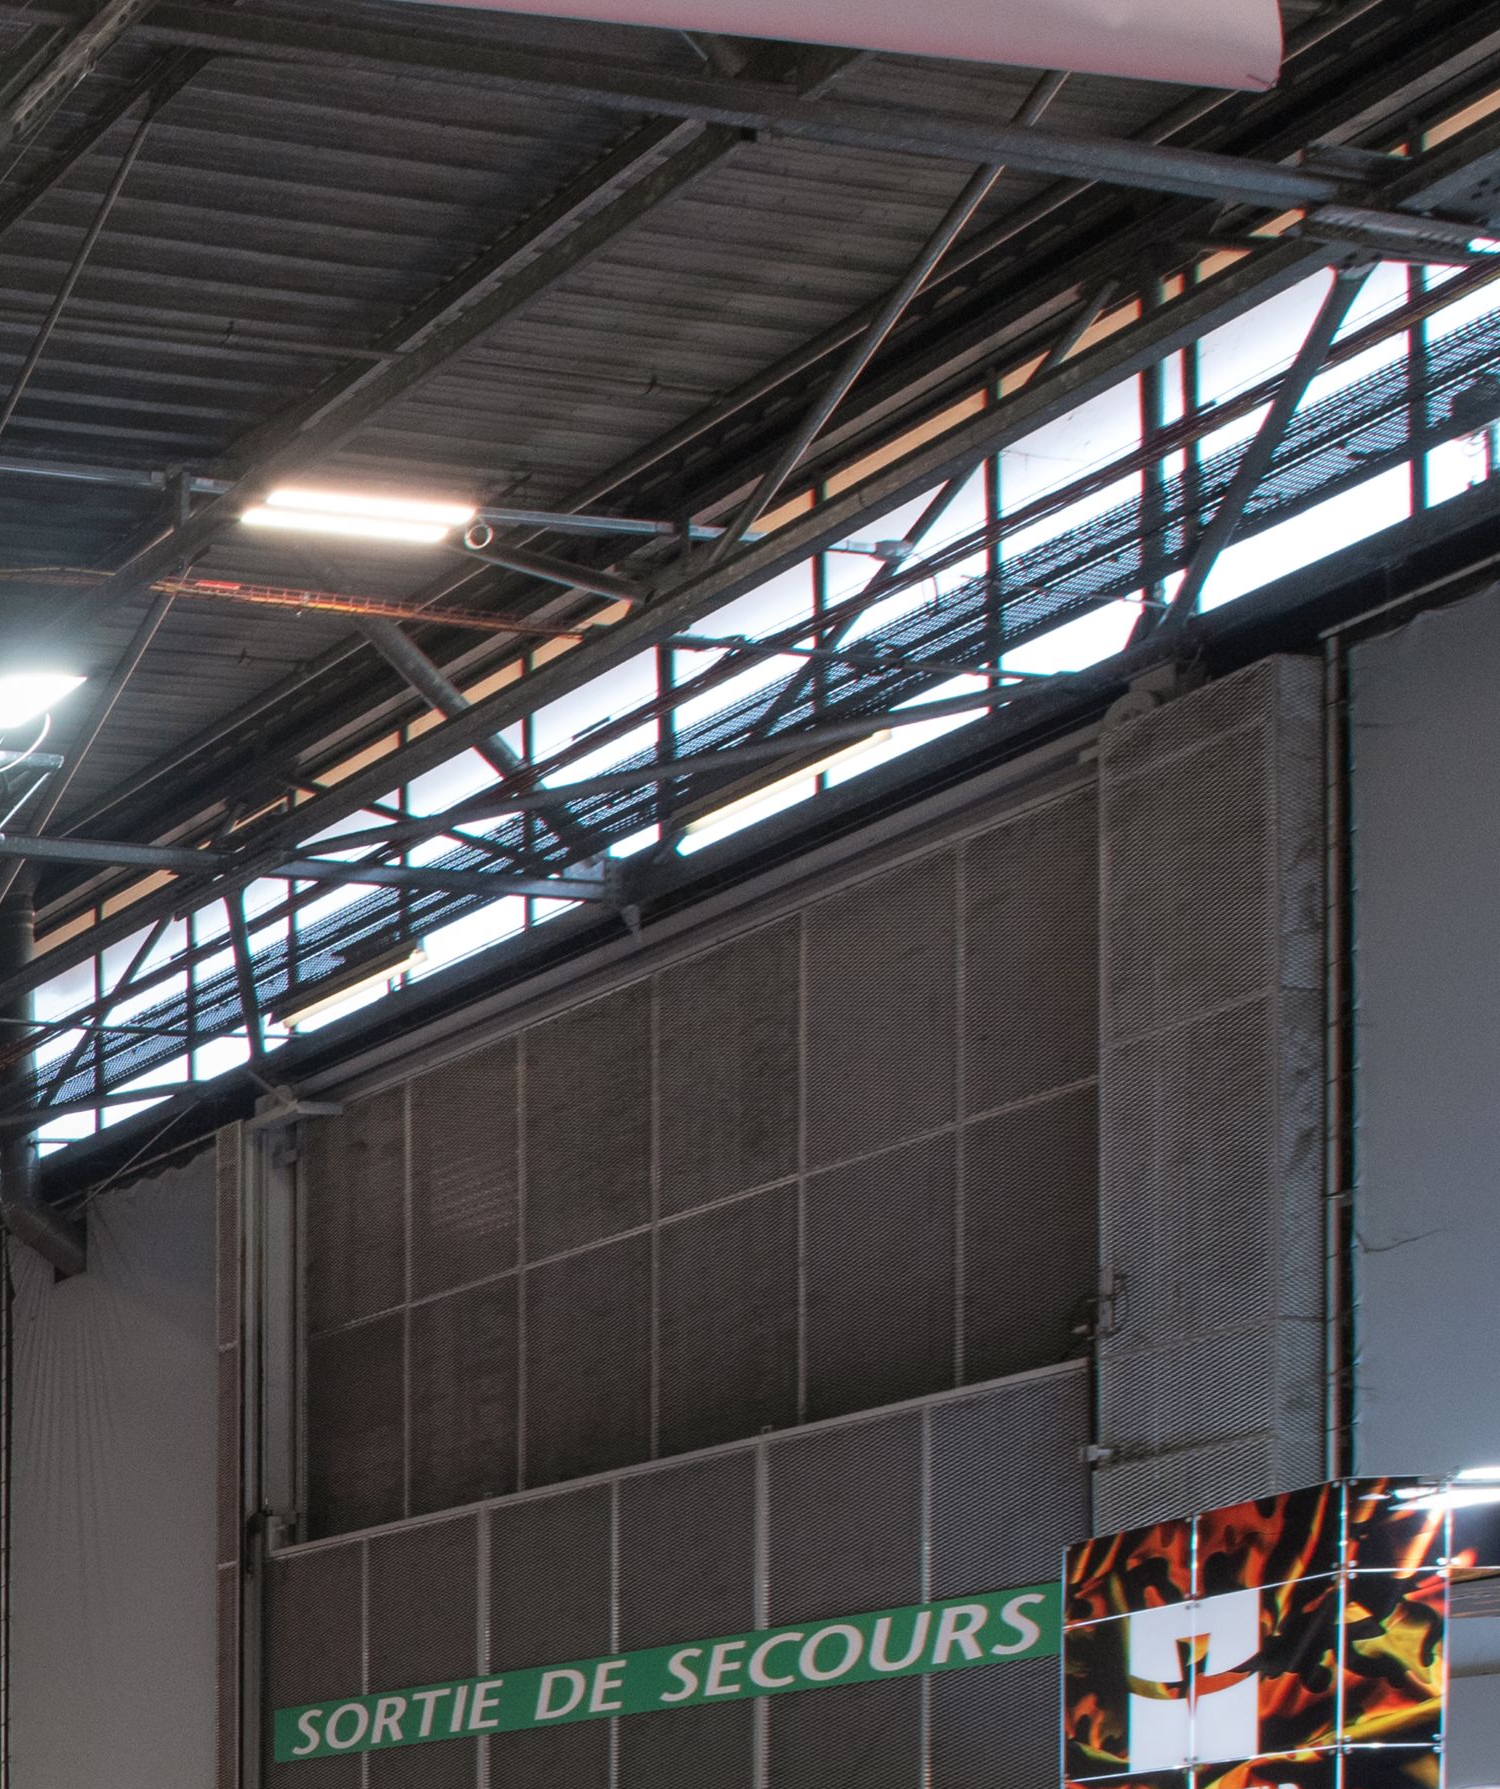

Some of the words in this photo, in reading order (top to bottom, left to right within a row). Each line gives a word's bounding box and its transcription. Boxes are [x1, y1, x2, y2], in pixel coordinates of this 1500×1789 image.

[291, 1679, 504, 1757] SORTIE
[534, 1660, 628, 1722] DE
[659, 1593, 1046, 1703] SECOURS
